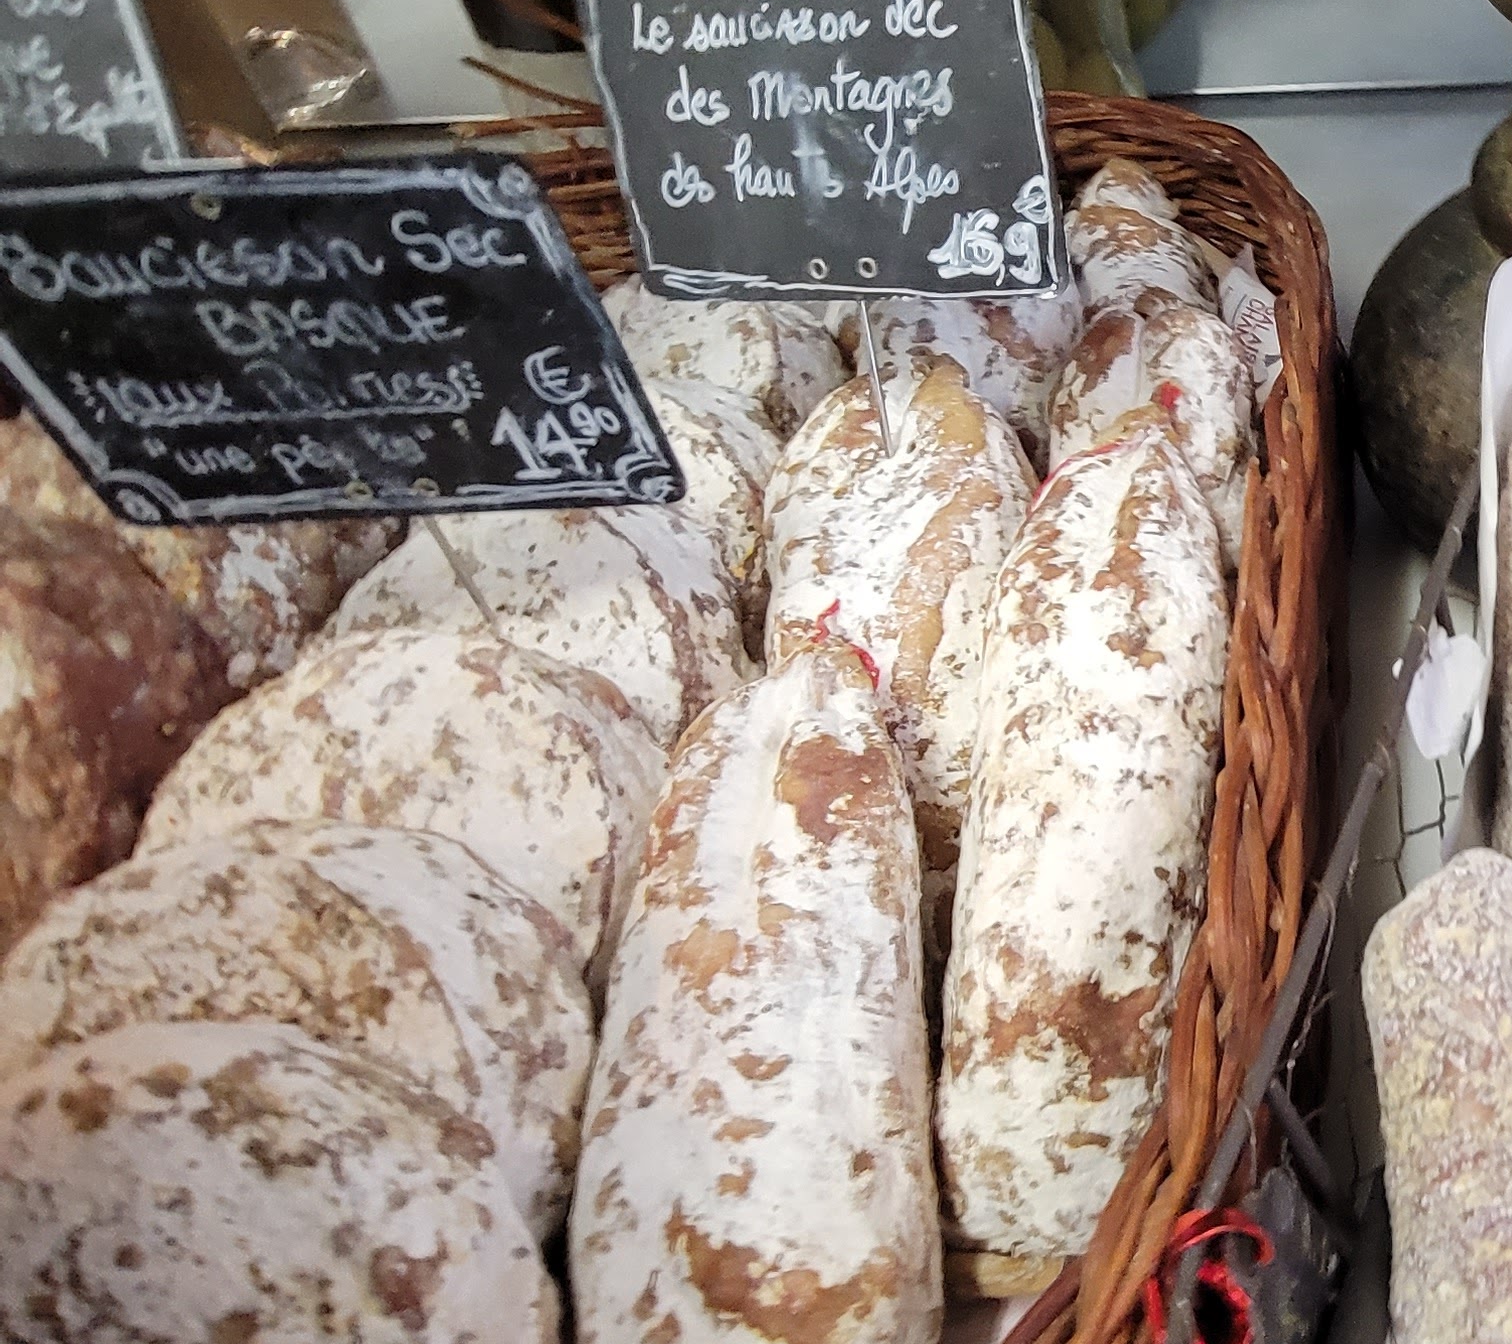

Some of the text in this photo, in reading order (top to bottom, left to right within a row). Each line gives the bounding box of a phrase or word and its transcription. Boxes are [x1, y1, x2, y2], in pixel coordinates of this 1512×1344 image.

[631, 1, 675, 55] Le
[665, 56, 954, 154] des Montagnes
[864, 146, 960, 236] Alpes
[391, 210, 527, 273] Sec
[194, 296, 467, 357] BASQUE
